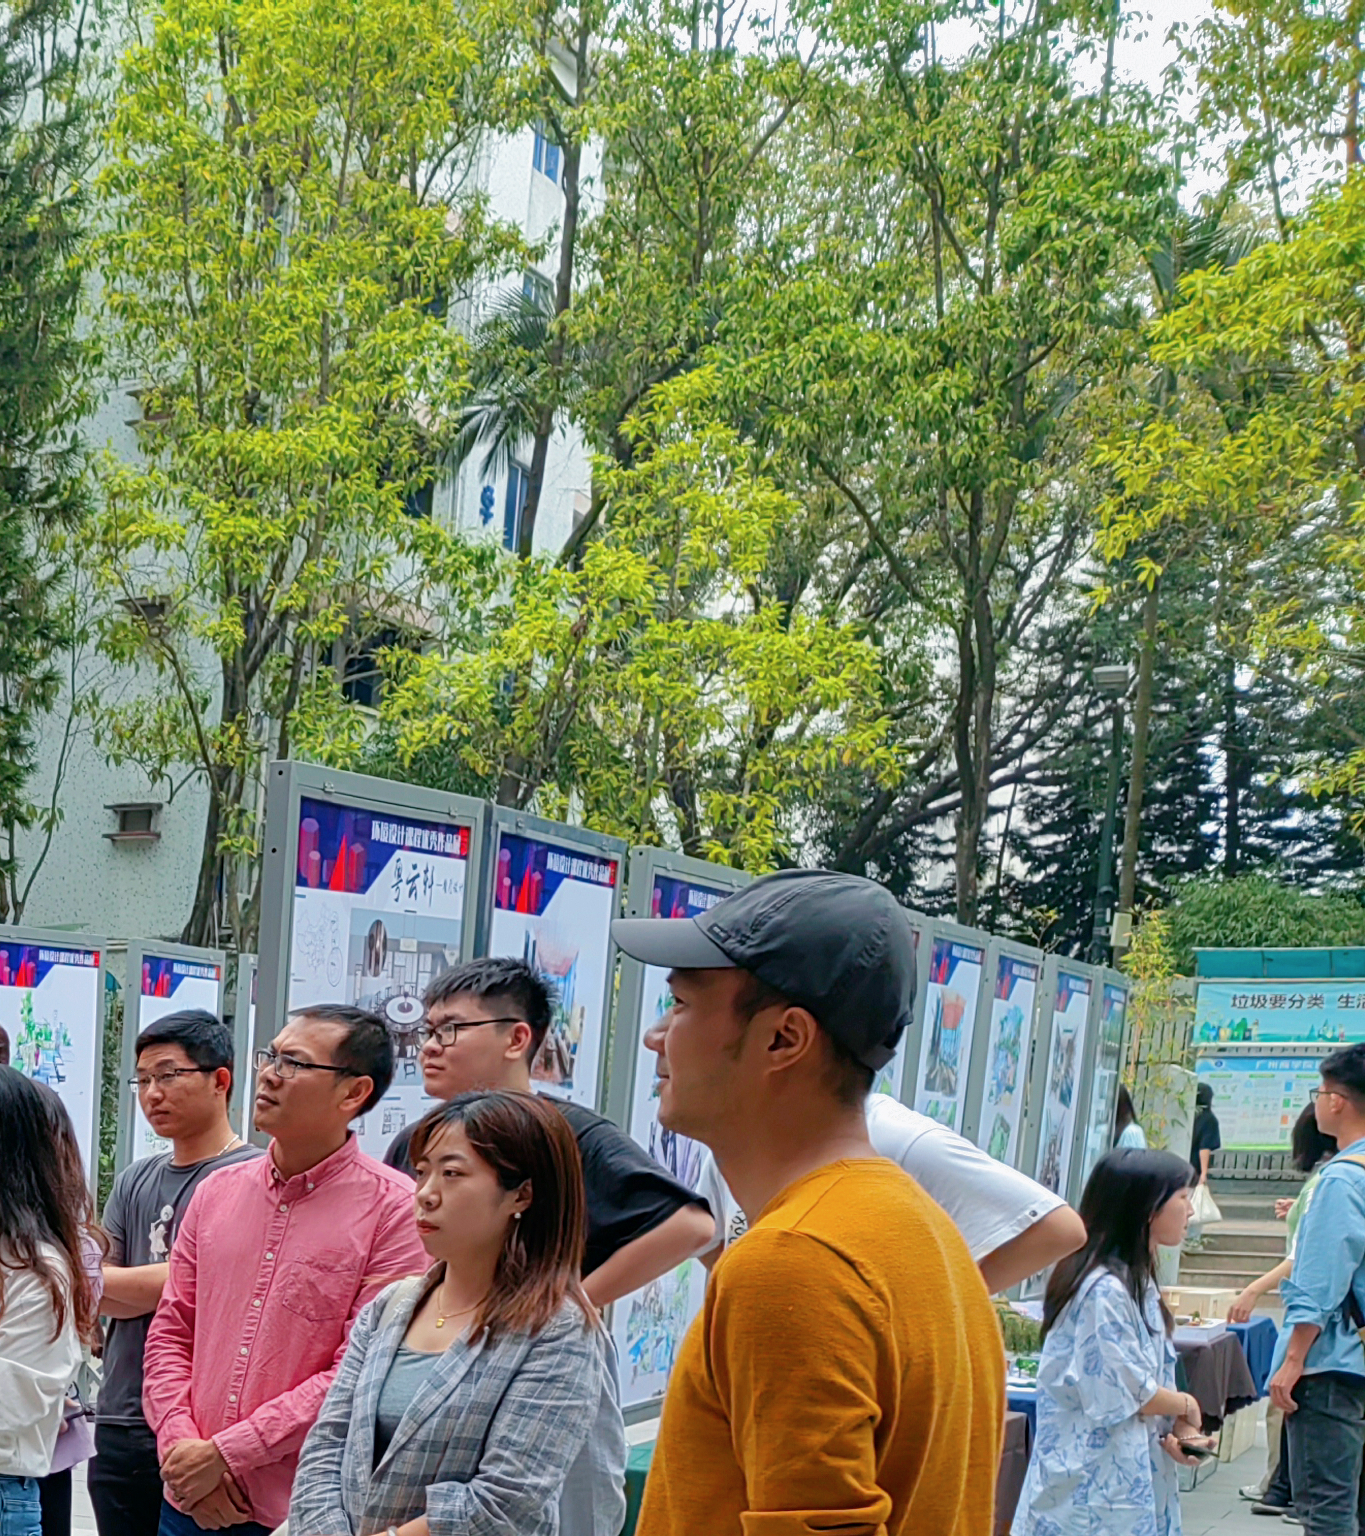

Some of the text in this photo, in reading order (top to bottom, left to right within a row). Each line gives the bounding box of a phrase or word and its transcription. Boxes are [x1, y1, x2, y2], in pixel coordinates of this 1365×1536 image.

[371, 820, 461, 855] 环境设计课程优秀作品展
[1231, 993, 1325, 1009] 垃圾要分类
[1255, 1060, 1319, 1069] 广州商学院
